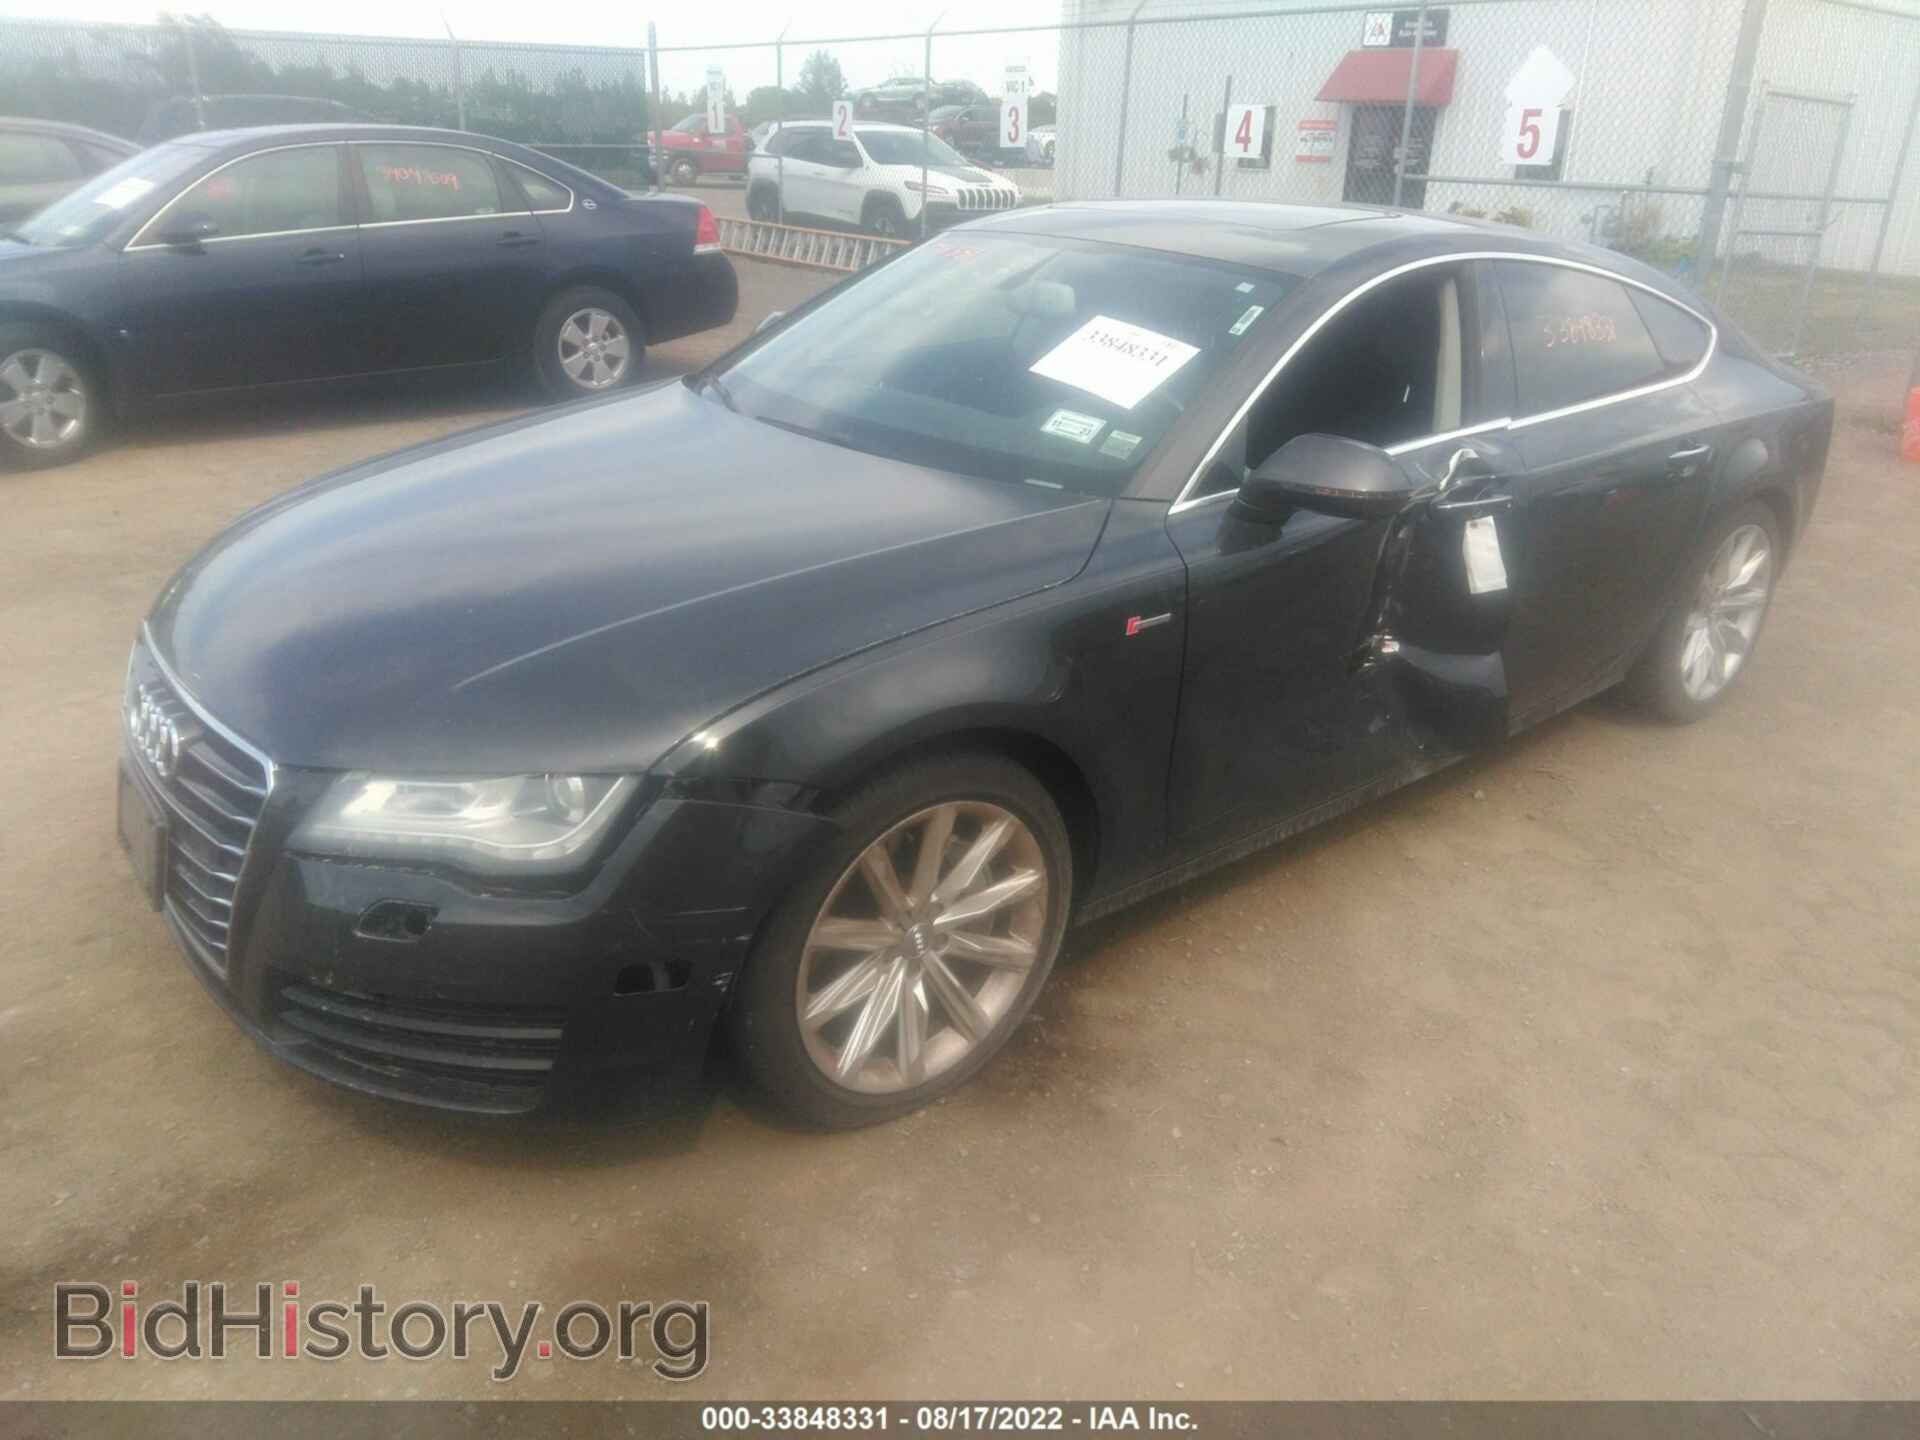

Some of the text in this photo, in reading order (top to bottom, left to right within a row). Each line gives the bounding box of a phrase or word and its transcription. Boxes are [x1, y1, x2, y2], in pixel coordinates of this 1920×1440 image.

[837, 104, 848, 137] 2
[1007, 106, 1020, 143] 3
[1234, 110, 1252, 153] 4
[1516, 108, 1543, 159] 5
